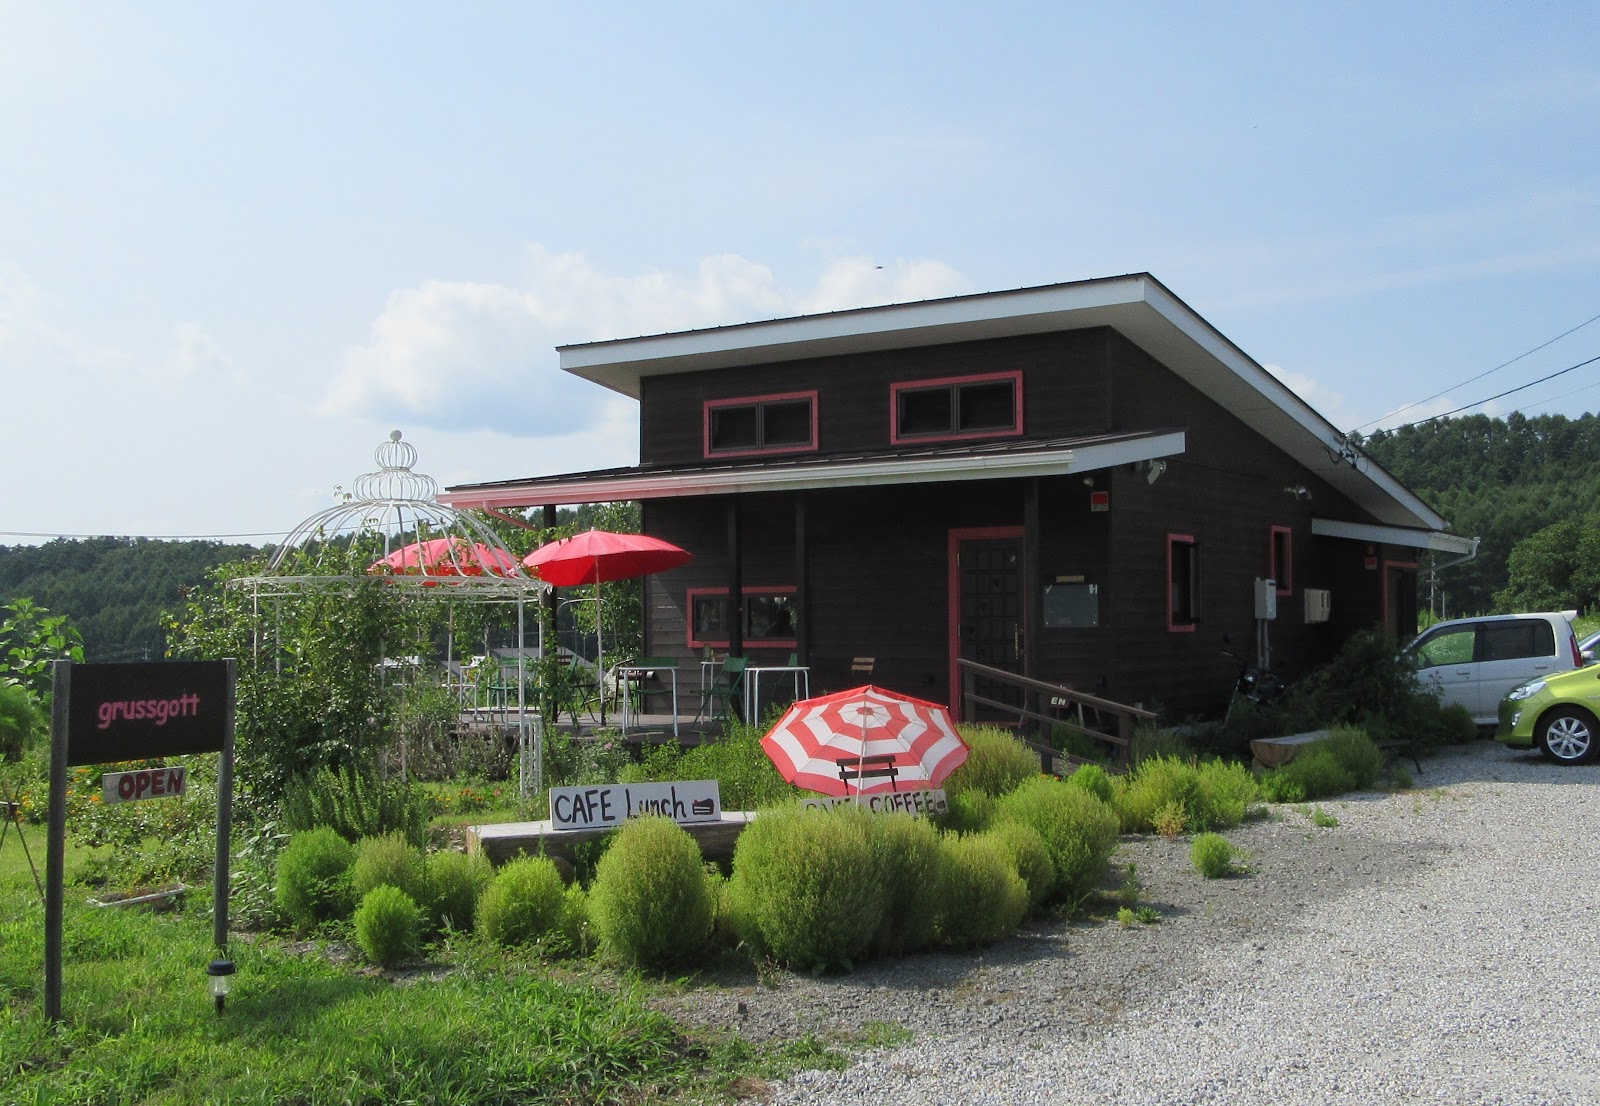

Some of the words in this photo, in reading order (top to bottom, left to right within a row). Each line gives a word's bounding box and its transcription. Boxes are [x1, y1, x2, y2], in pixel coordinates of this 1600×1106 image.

[98, 693, 200, 729] grussgott
[118, 769, 184, 800] OPEN
[554, 789, 616, 824] CAFE
[625, 786, 687, 819] Lunch
[869, 791, 935, 815] COFFEE
